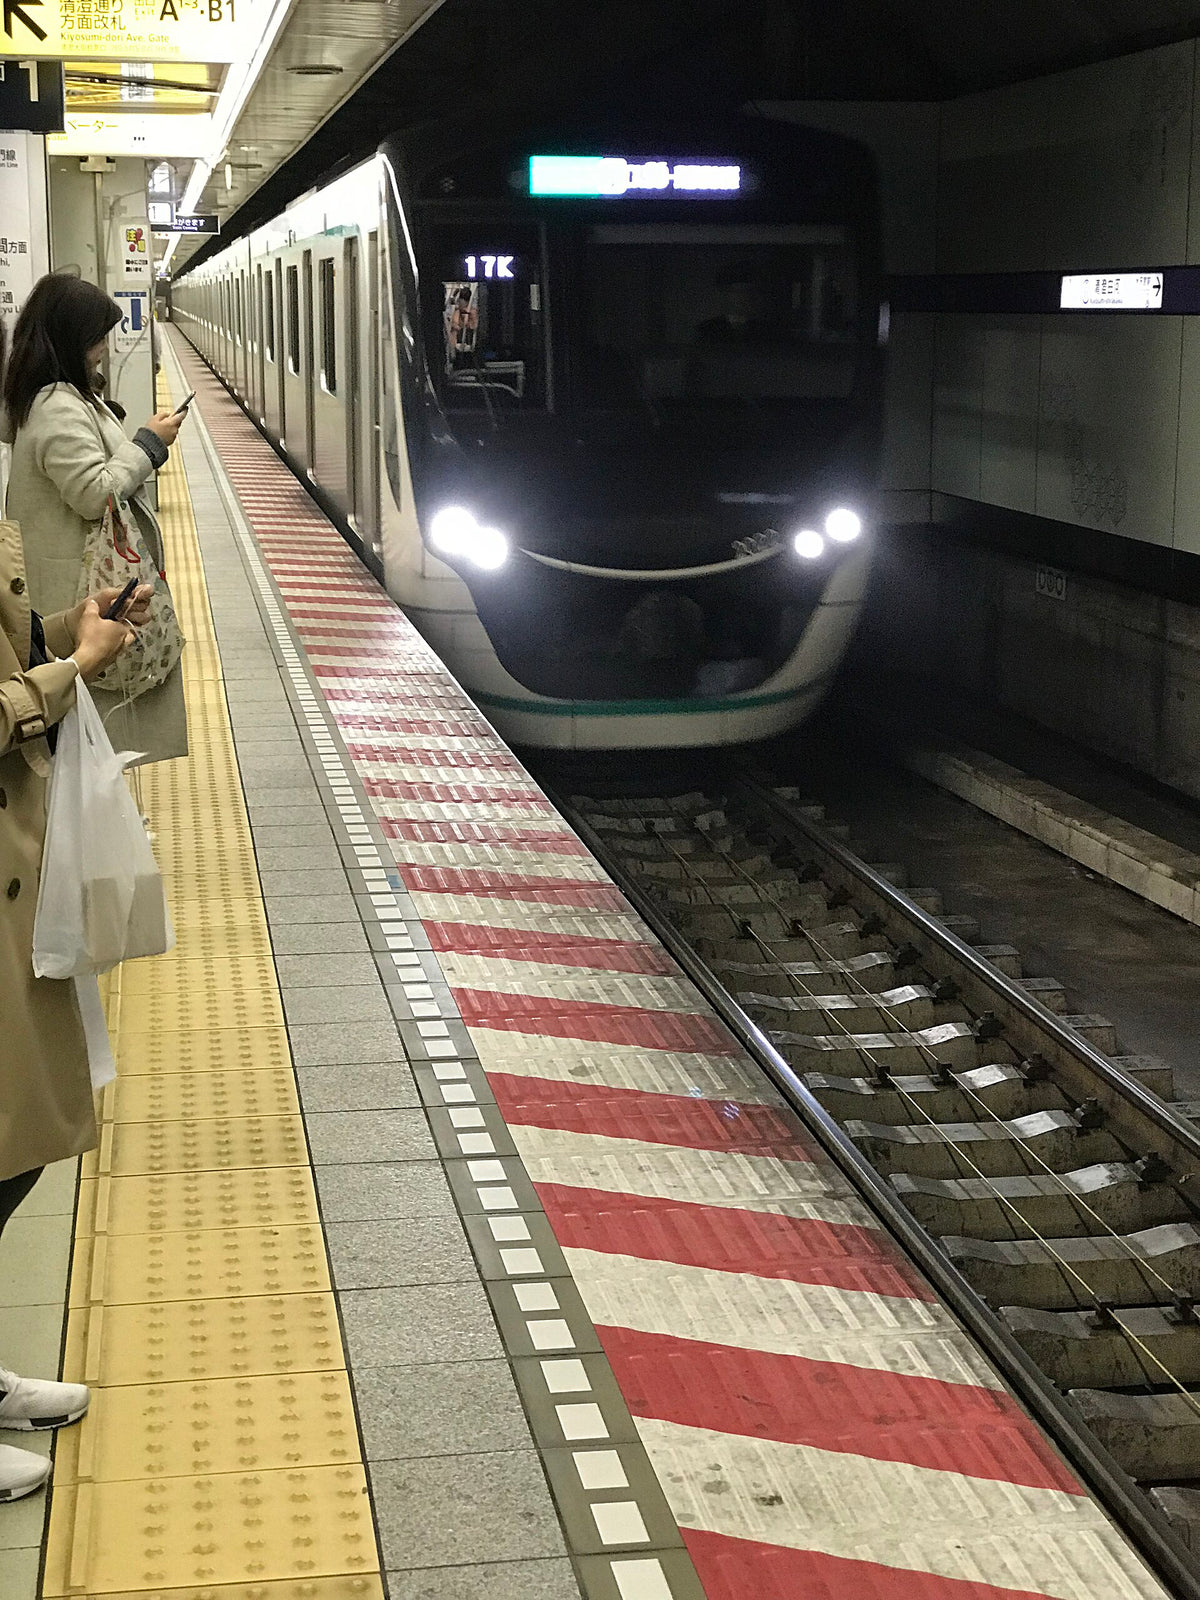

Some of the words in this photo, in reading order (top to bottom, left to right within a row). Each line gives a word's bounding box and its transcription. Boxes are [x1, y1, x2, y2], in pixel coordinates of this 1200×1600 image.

[60, 14, 126, 30] 方面改札
[60, 33, 124, 42] Kiyosumi-dori
[148, 33, 170, 43] Gate
[19, 60, 39, 102] 1
[464, 255, 514, 278] 17K
